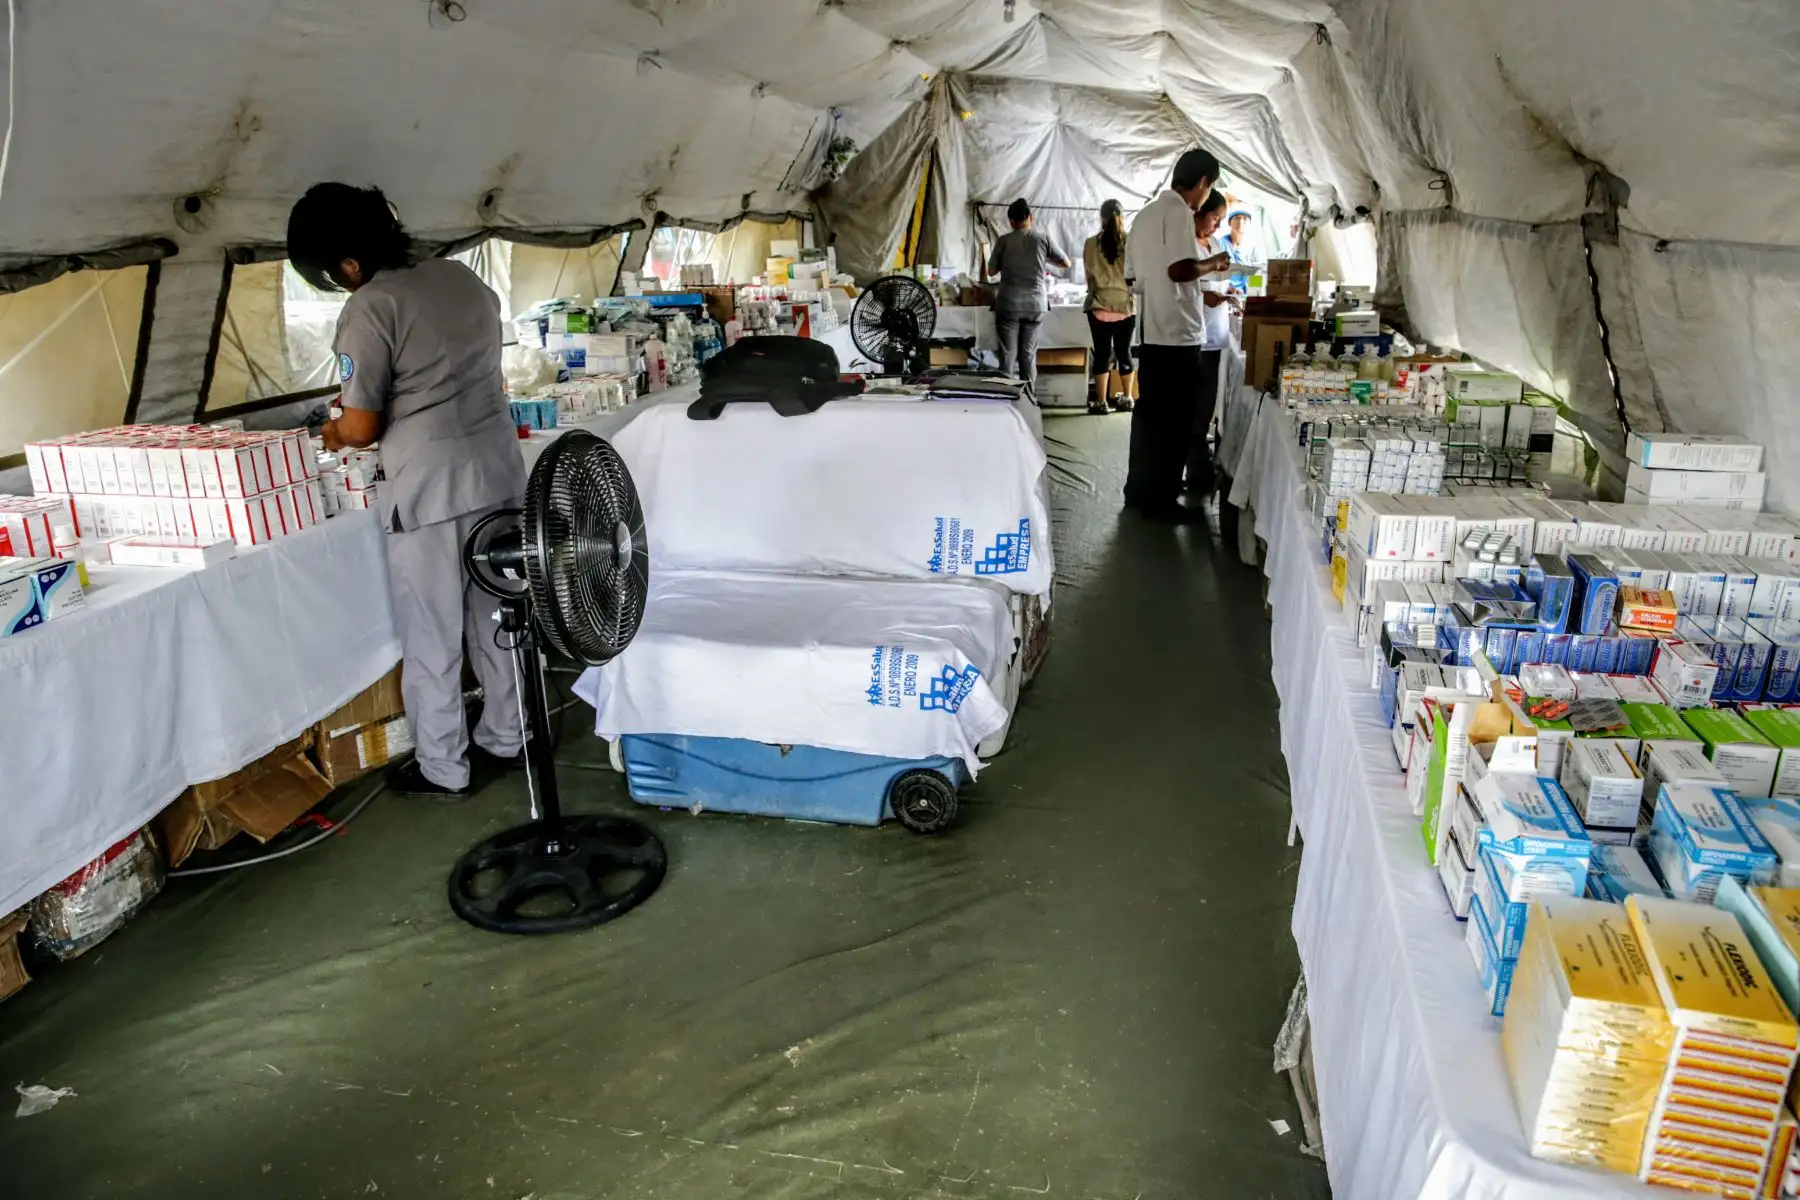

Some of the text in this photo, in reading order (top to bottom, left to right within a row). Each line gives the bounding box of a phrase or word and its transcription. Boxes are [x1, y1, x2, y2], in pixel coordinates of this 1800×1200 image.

[934, 516, 943, 554] EsSalud
[961, 529, 974, 565] ENERO 2009
[1007, 536, 1019, 570] EsSalud
[1017, 521, 1030, 569] EMPRESA
[904, 654, 919, 697] ENERO 2009
